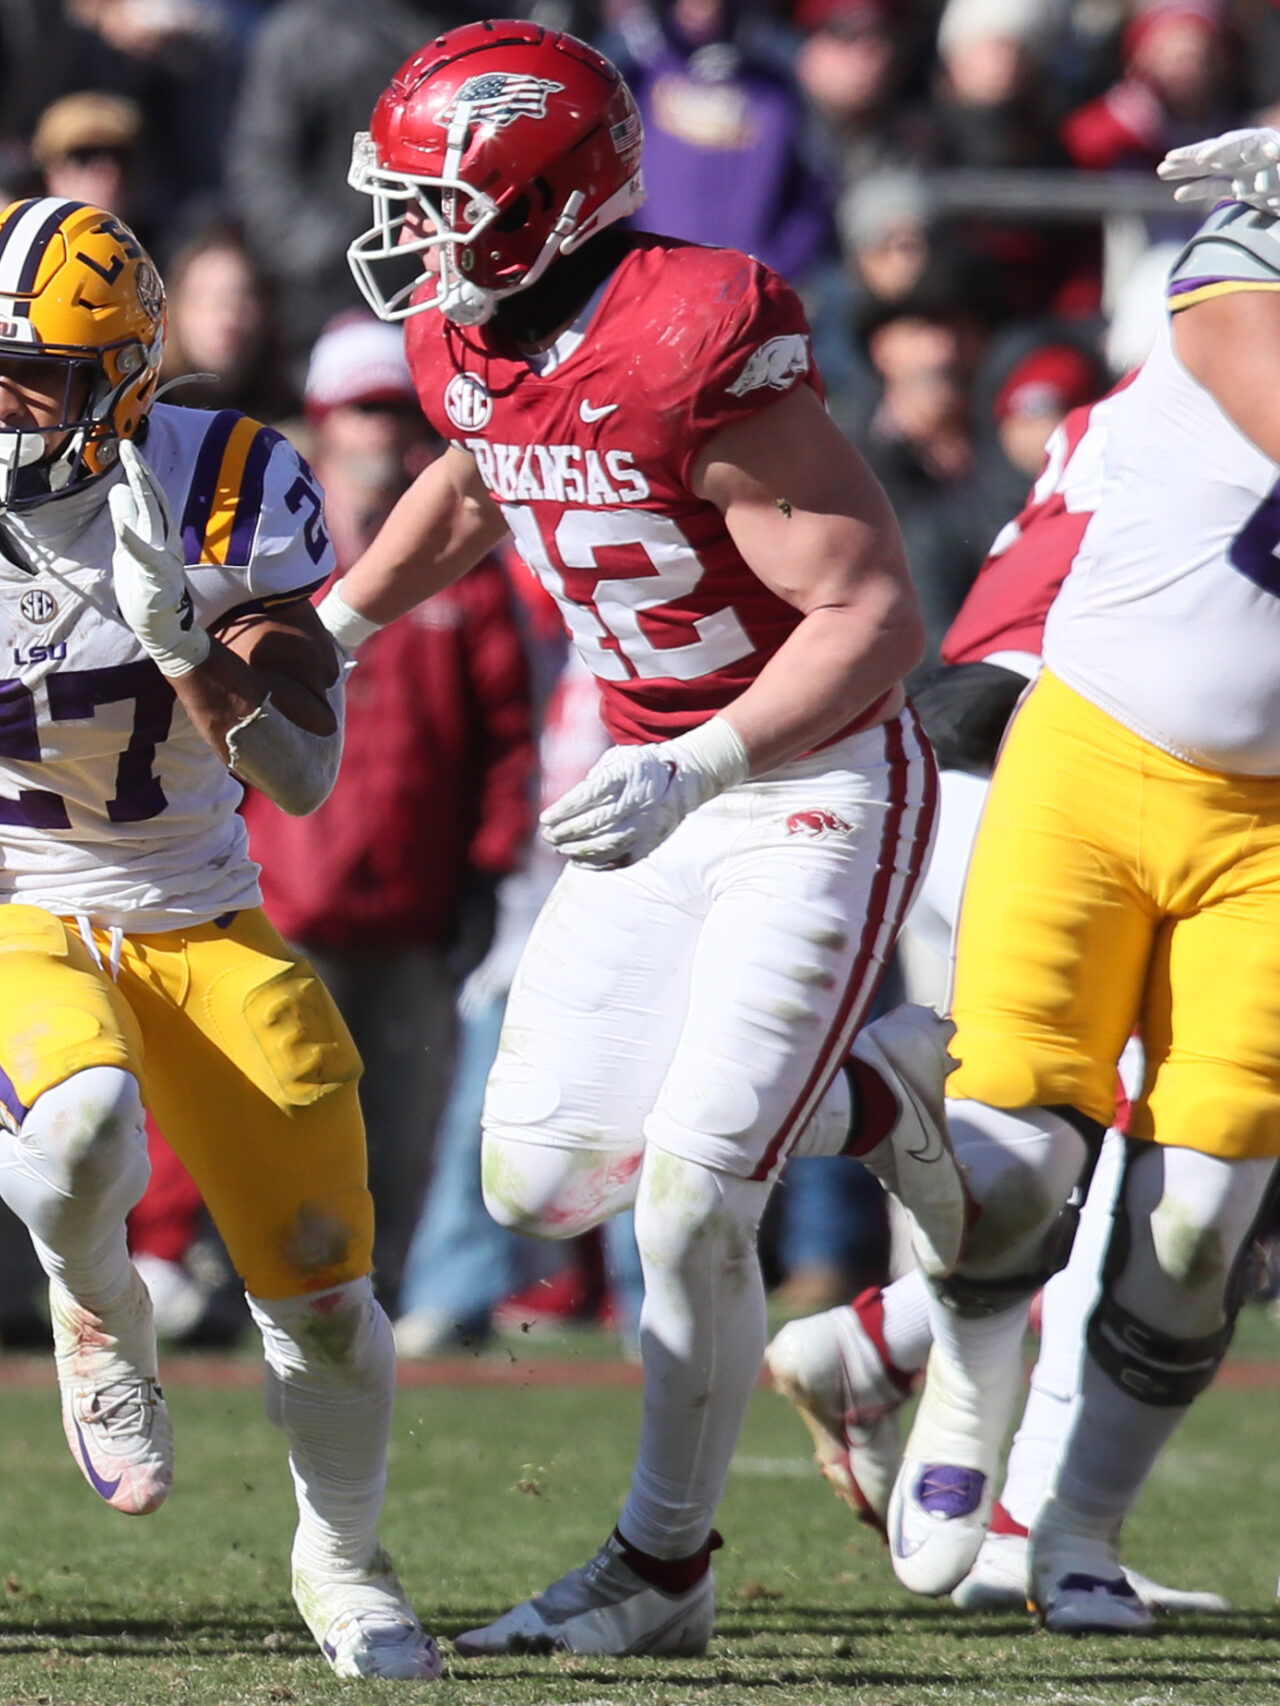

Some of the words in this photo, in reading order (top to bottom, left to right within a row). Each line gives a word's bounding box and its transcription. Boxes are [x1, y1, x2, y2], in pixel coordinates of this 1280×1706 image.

[448, 377, 489, 430] SEC
[450, 437, 650, 506] RKANSAS
[21, 591, 56, 623] SEC
[13, 640, 68, 667] LSU
